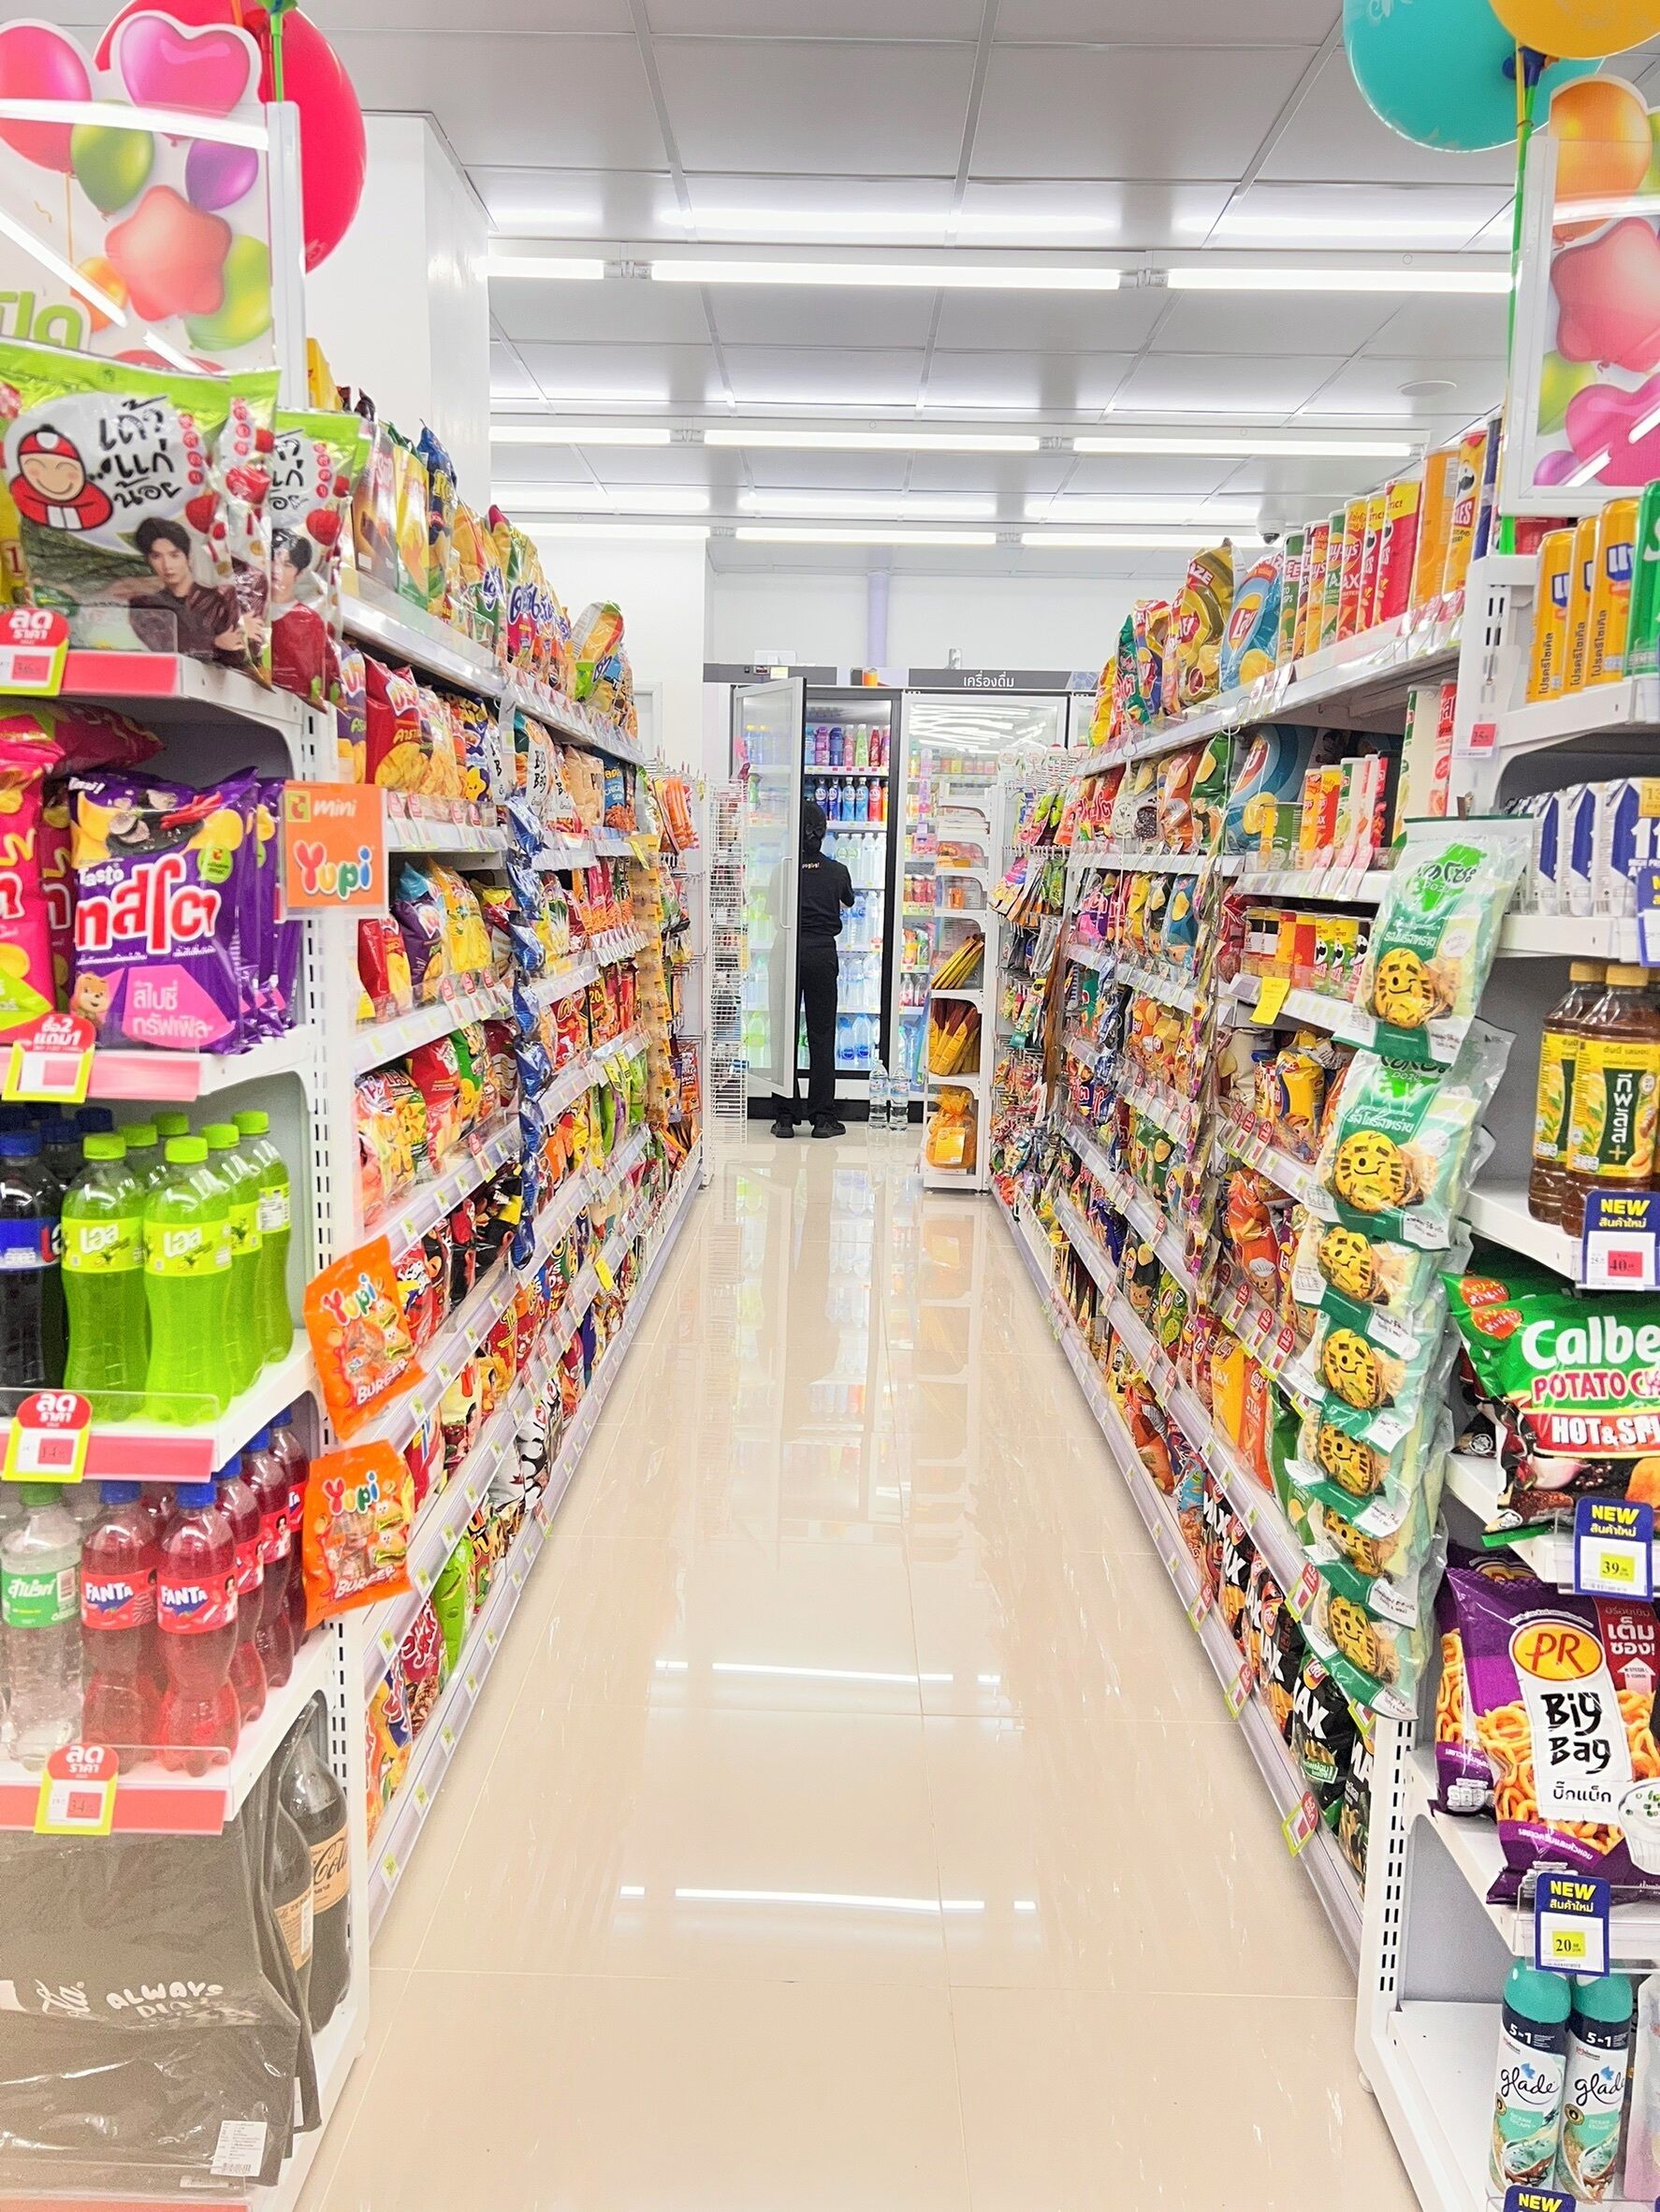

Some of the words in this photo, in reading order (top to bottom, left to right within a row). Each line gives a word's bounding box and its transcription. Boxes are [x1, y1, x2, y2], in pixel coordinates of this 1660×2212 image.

[963, 671, 1015, 689] เครื่องดื่ม
[313, 798, 357, 818] mini
[293, 839, 372, 901] Yupi
[1600, 1199, 1651, 1216] NEW
[1598, 1217, 1648, 1229] สินค้าใหม่
[321, 1273, 376, 1327] Yupi
[357, 1358, 408, 1405] BURGER
[1534, 1372, 1626, 1401] POTATO
[36, 1392, 78, 1414] ลด
[322, 1470, 380, 1517] Yupi
[1591, 1504, 1639, 1526] NEW
[1590, 1523, 1638, 1537] สินค้าใหม่
[84, 1581, 135, 1603] FANTA
[334, 1564, 397, 1600] BURGER
[160, 1584, 209, 1607] FANTA
[1608, 1616, 1655, 1641] เต็ม
[1524, 1633, 1585, 1674] PR
[1610, 1641, 1655, 1656] ซอง!
[1539, 1691, 1603, 1737] Big
[65, 1744, 106, 1766] ลด
[1548, 1736, 1612, 1775] Bag
[1550, 1880, 1596, 1901] NEW
[1549, 1899, 1594, 1914] สินค้าใหม่
[1555, 1939, 1572, 1953] 20
[105, 1980, 225, 2011] ALWAYS
[1500, 2066, 1561, 2105] glade
[1518, 2191, 1563, 2212] NEW
